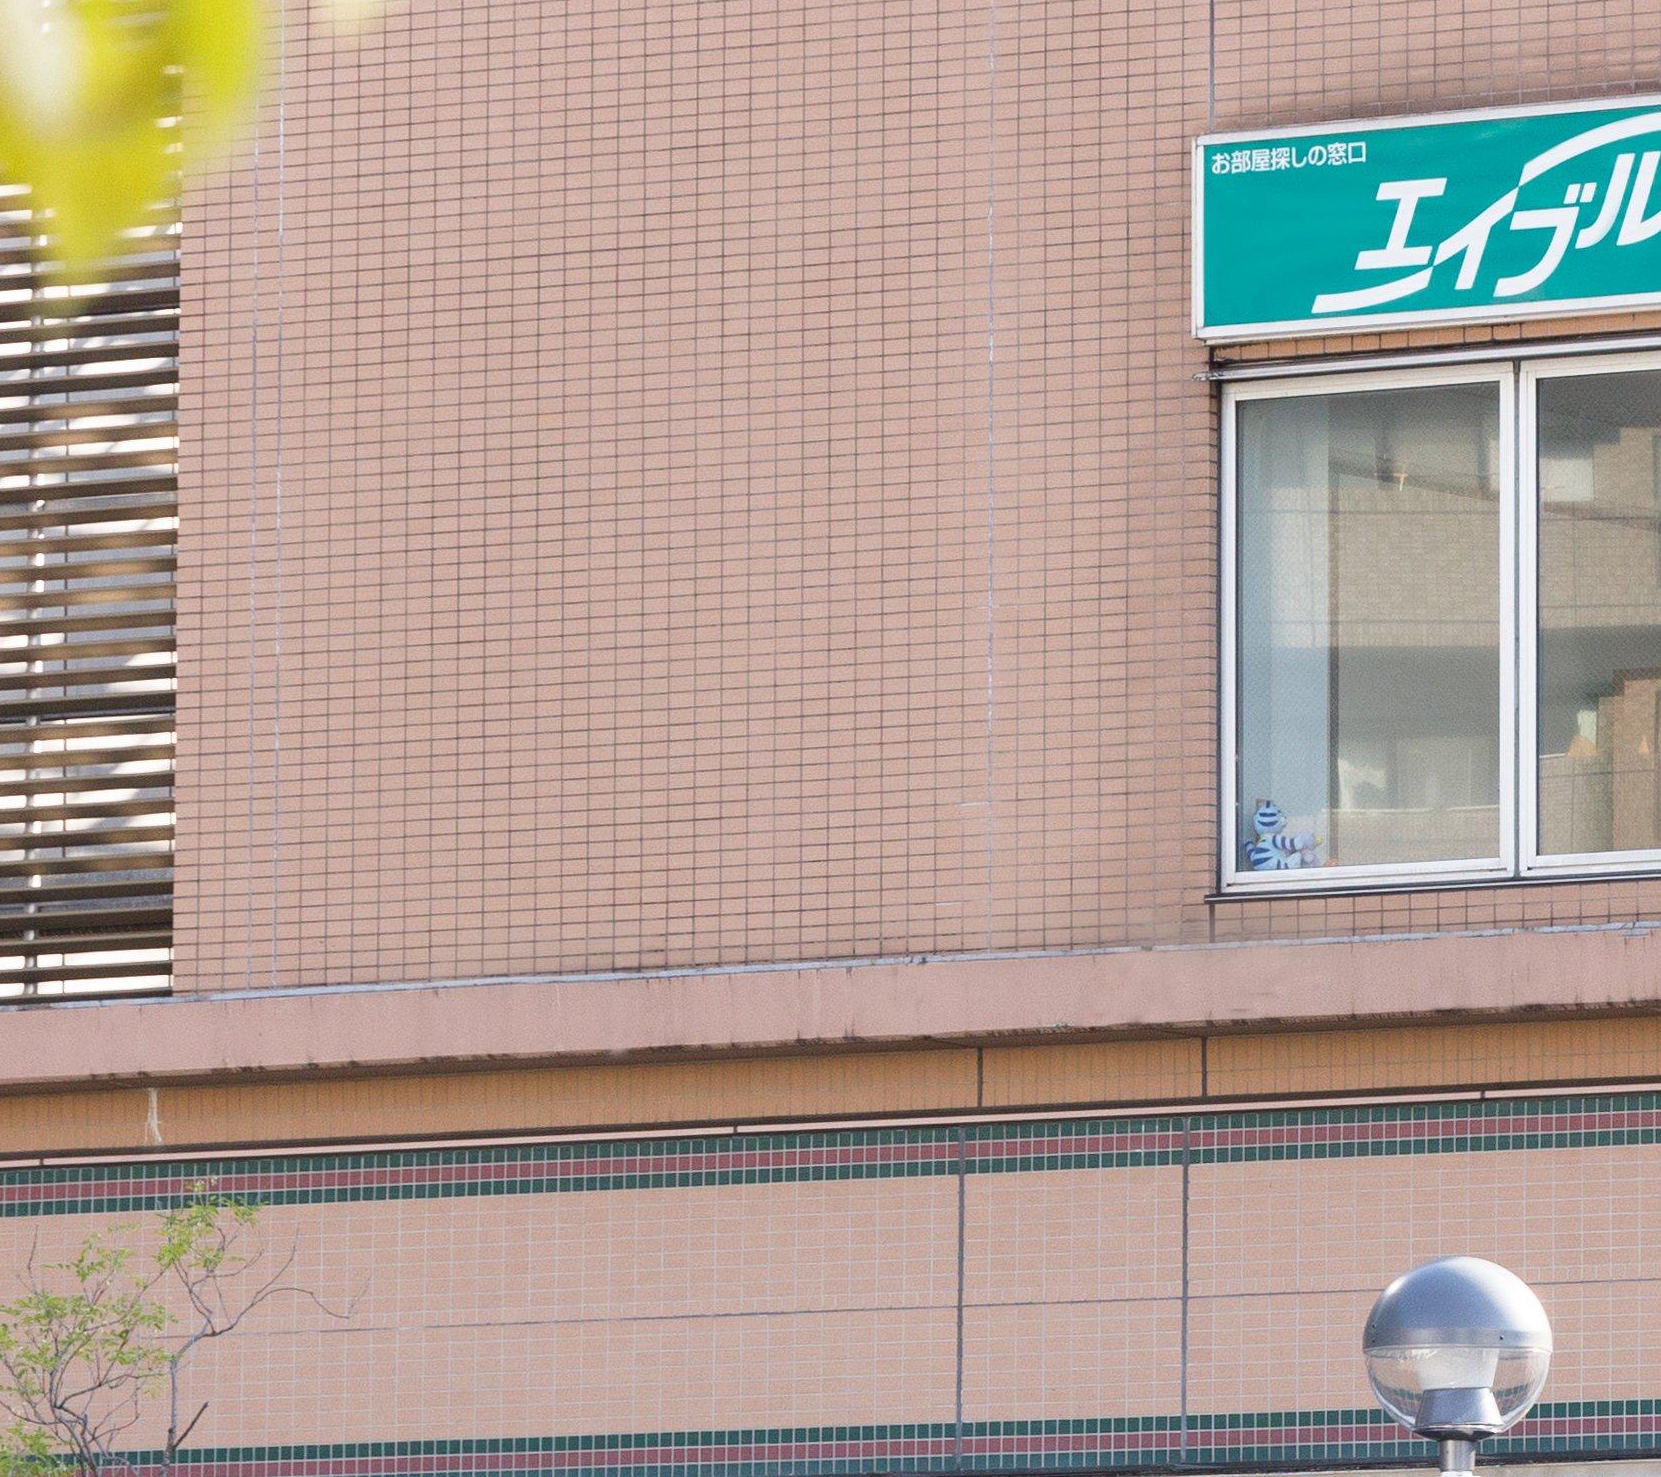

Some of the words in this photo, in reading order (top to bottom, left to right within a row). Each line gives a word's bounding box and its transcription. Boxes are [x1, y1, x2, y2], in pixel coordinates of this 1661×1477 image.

[1211, 141, 1367, 175] お部屋探しの窓口
